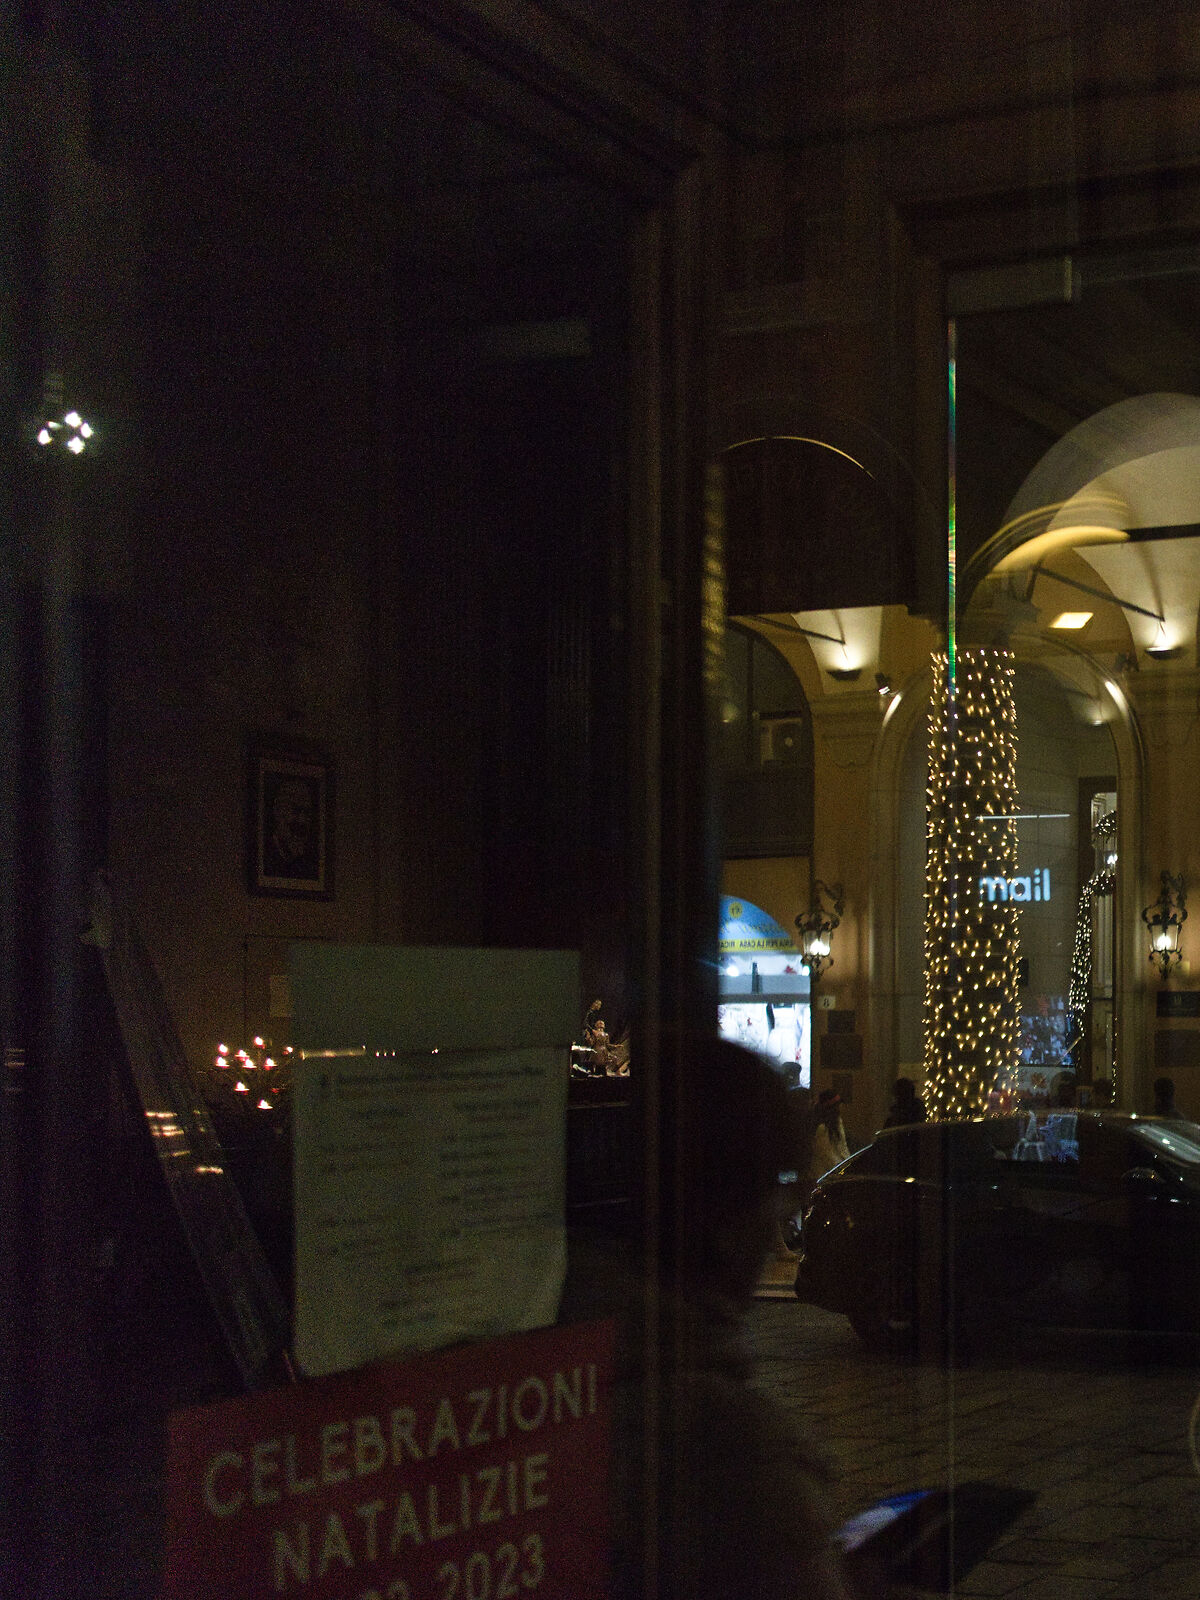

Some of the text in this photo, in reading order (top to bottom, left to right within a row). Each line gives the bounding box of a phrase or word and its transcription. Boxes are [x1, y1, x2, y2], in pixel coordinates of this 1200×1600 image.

[204, 1364, 598, 1518] CELEBRAZIONI
[272, 1452, 550, 1592] NATALIZIE
[435, 1533, 546, 1600] 2023
